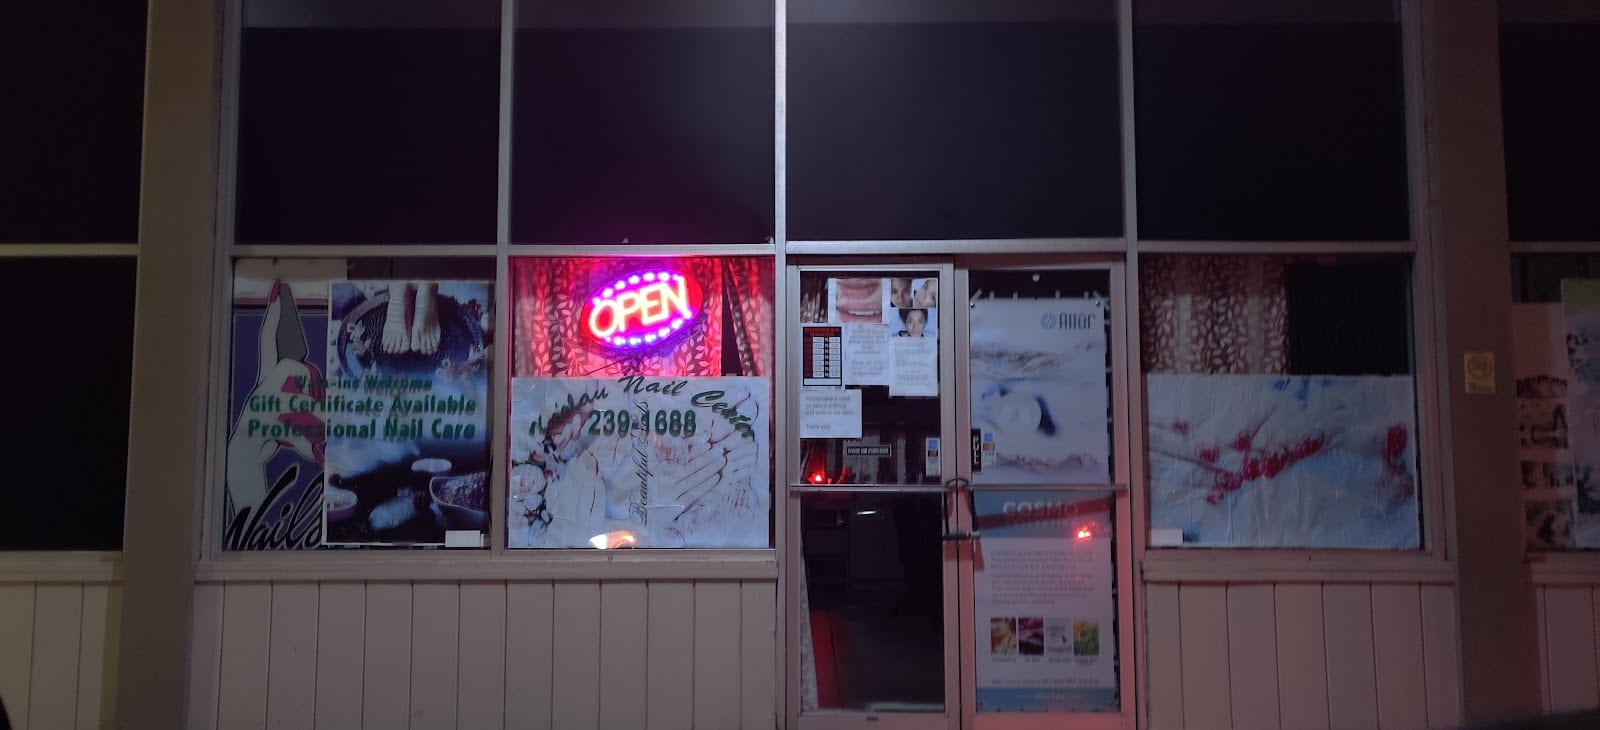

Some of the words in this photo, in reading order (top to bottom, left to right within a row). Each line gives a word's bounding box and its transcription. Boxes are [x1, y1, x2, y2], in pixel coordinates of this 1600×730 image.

[589, 276, 692, 338] OPEN
[365, 375, 432, 393] Welcome
[617, 375, 689, 397] Nail
[249, 395, 281, 413] Gift
[289, 395, 384, 413] Certificate
[391, 395, 477, 413] Available
[248, 419, 376, 438] Professional
[384, 419, 424, 439] Nail
[431, 419, 476, 440] Care
[628, 446, 655, 527] Beautiful
[224, 465, 324, 551] Nails
[1002, 500, 1080, 519] COSMO
